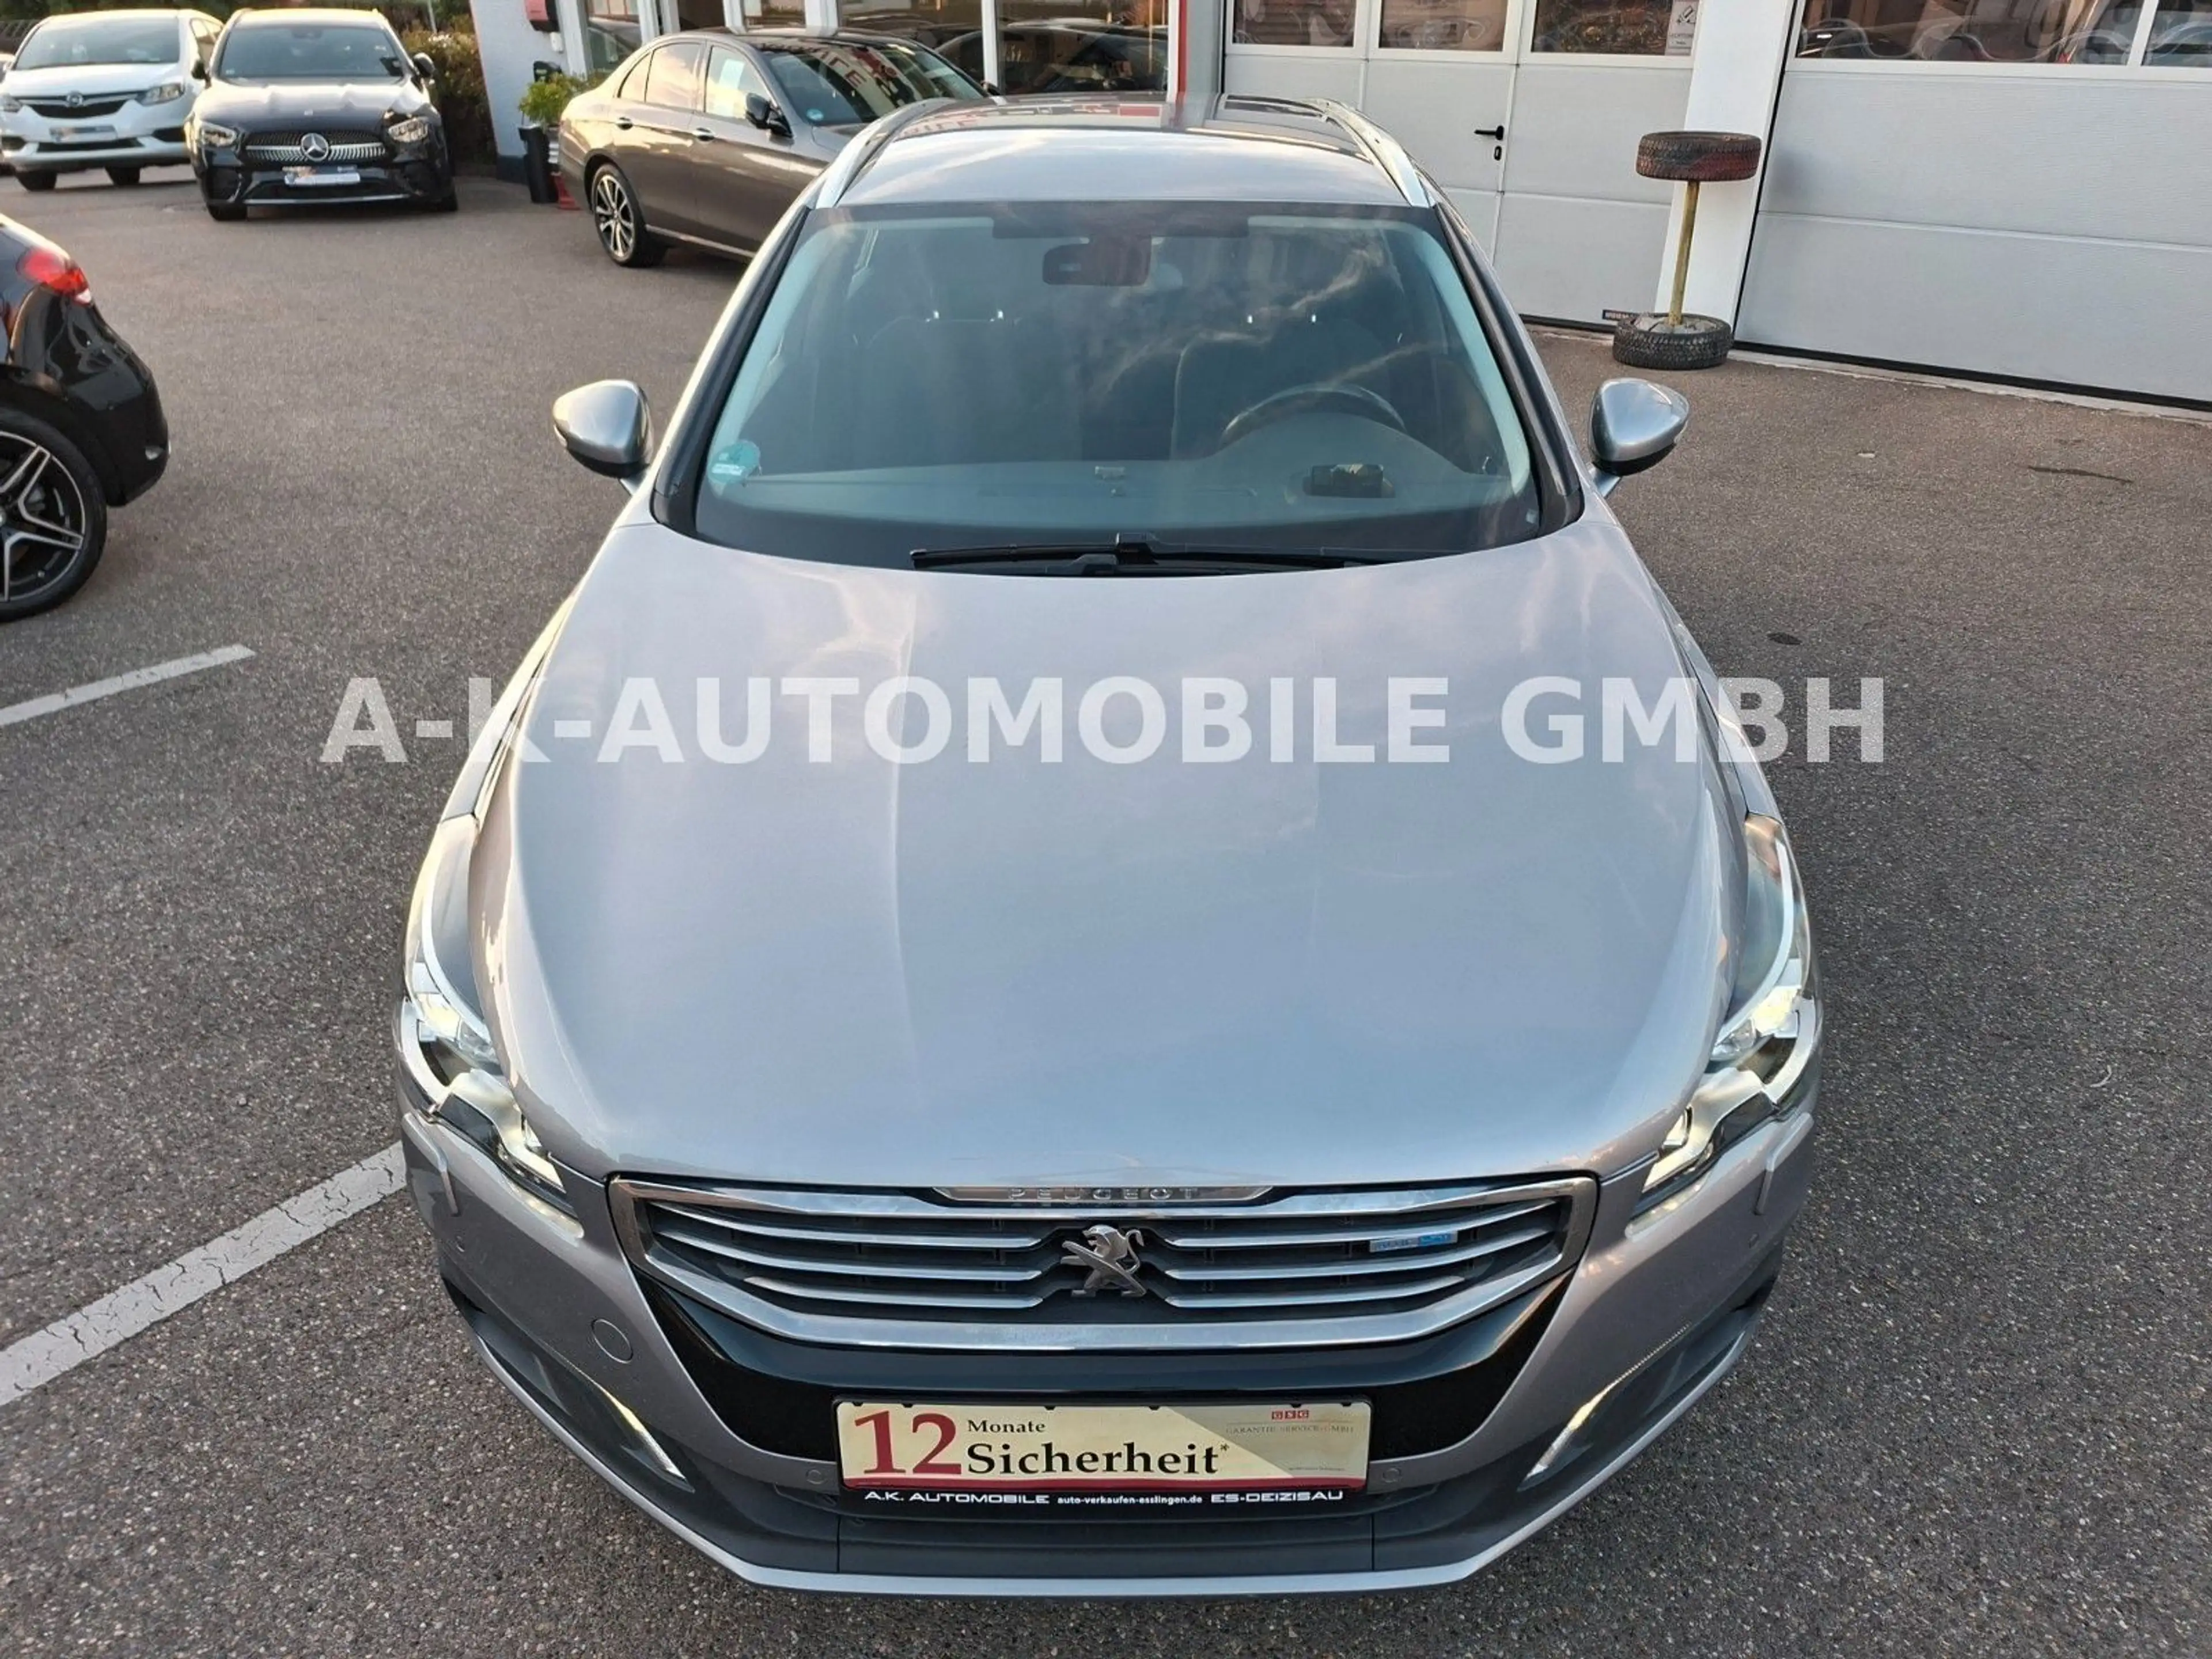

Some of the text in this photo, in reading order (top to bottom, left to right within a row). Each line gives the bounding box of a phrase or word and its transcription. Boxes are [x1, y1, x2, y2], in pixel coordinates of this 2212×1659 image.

[1008, 1187, 1198, 1200] PEUGEOT
[968, 1420, 1046, 1433] Monate
[855, 1410, 961, 1475] 12
[865, 1491, 1343, 1505] A.K. AUTOMOBILE auto-verkaufen-esslingen.de ES-DEIZISAU
